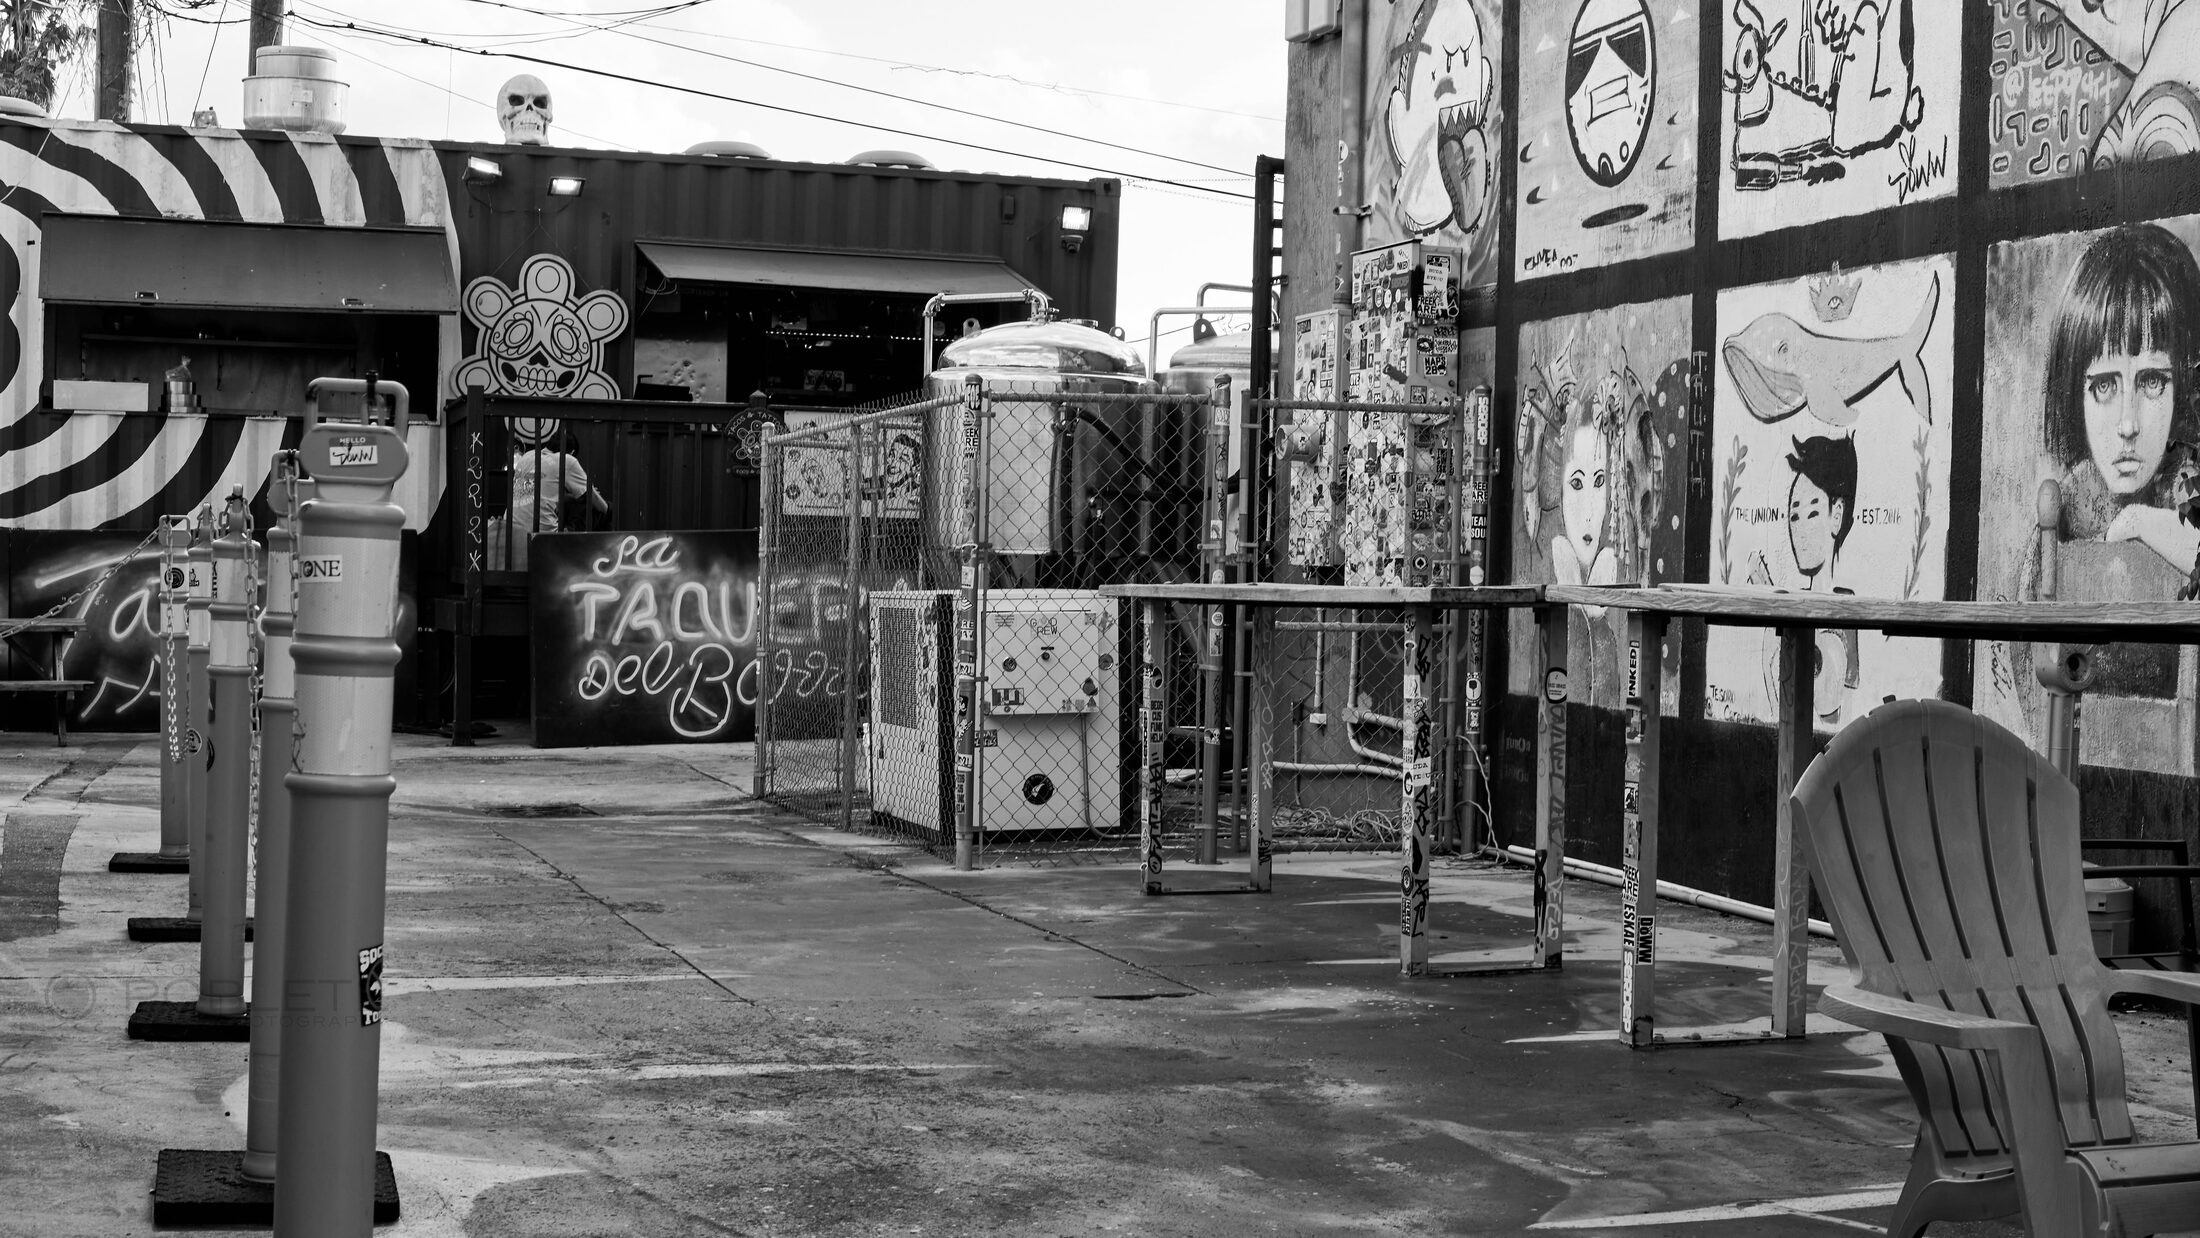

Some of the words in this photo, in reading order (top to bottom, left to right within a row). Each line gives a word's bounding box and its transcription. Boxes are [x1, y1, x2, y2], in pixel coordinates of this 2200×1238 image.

[728, 414, 746, 436] TACOS
[339, 436, 366, 444] HELLO
[1736, 507, 1749, 522] THE
[1750, 506, 1779, 526] UNION
[1627, 648, 1638, 698] INKED
[1621, 880, 1639, 898] ARE
[1623, 903, 1636, 948] ESKAE
